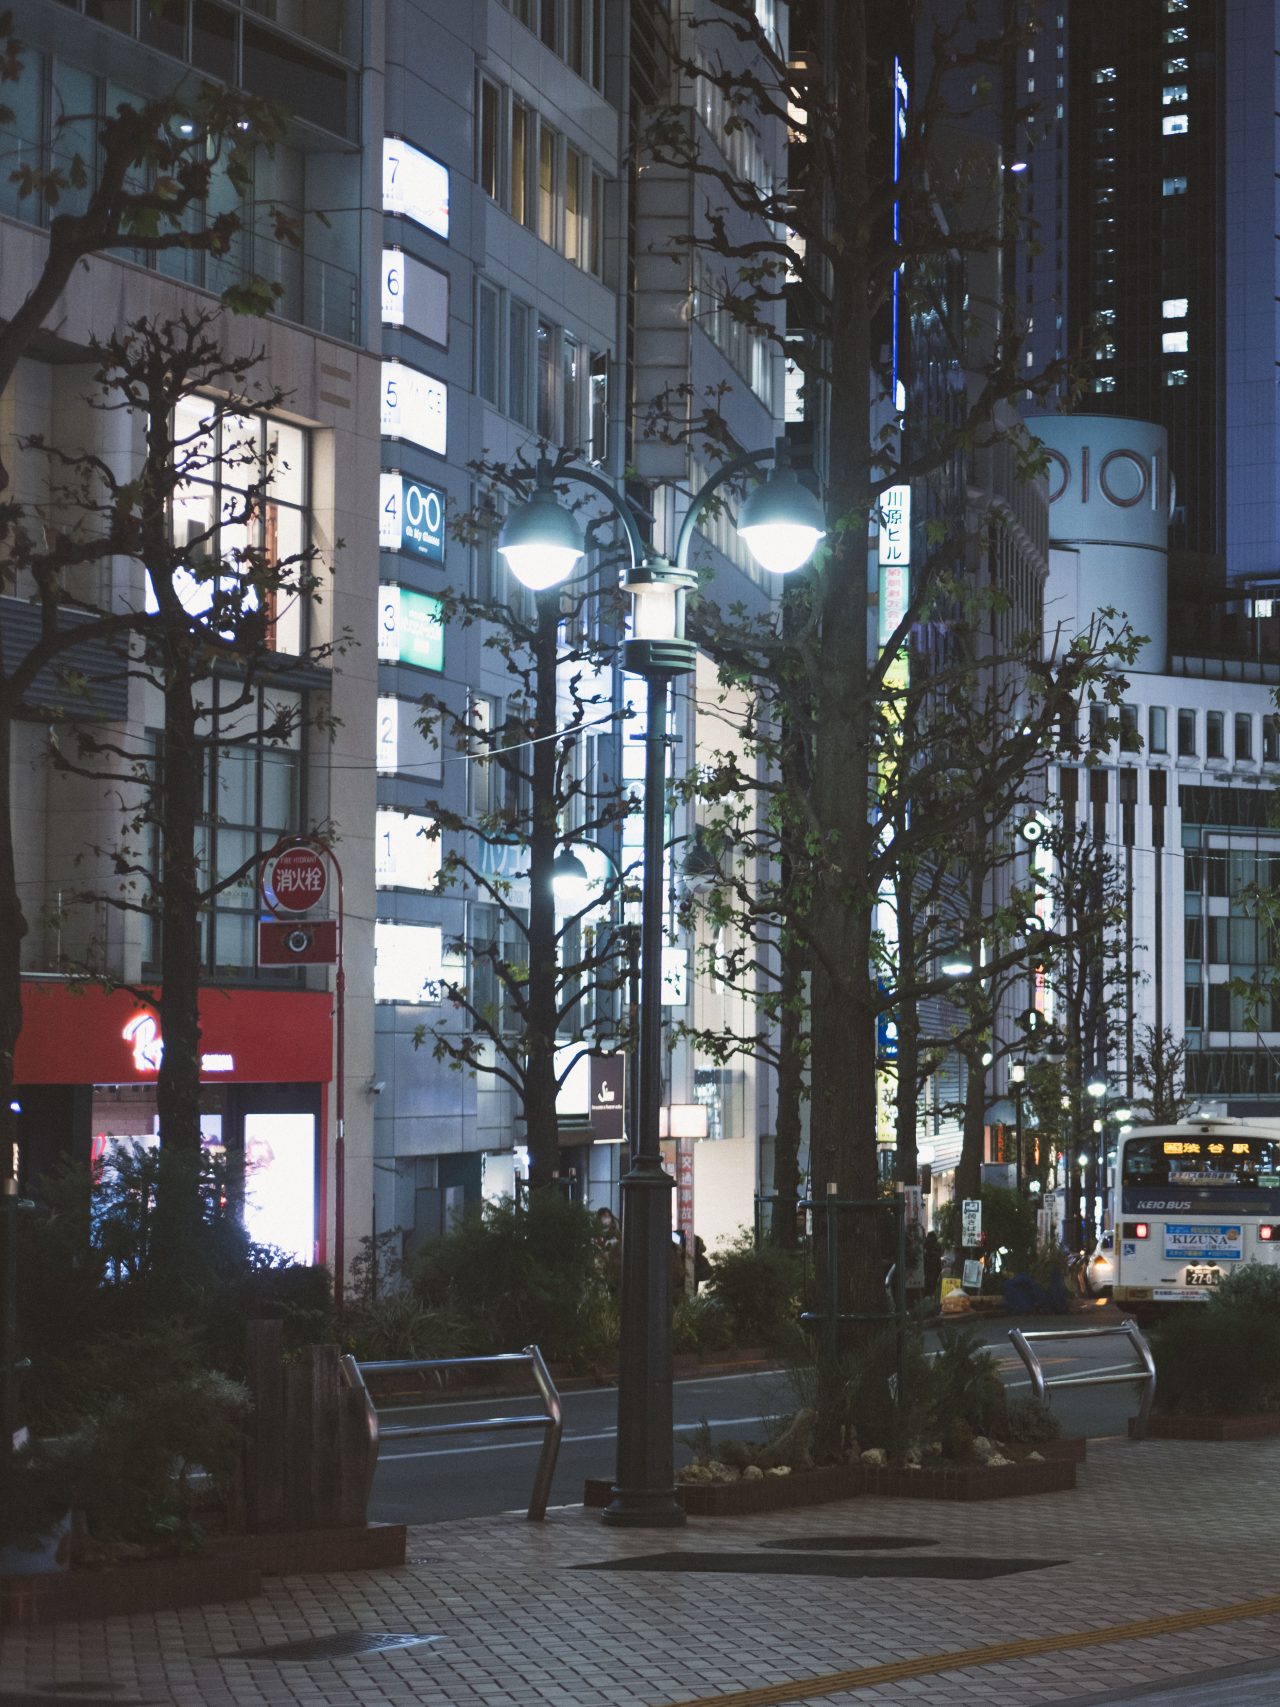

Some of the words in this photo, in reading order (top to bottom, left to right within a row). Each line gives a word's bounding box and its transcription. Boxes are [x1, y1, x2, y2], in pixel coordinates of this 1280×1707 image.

[388, 156, 400, 184] 7
[387, 268, 400, 296] 6
[386, 381, 398, 408] 5
[384, 493, 397, 520] 4
[383, 604, 395, 632] 3
[381, 716, 394, 744] 2
[383, 831, 391, 857] 1
[276, 867, 322, 893] 消火栓
[1137, 1200, 1166, 1209] KEIO
[1166, 1200, 1193, 1210] BUS
[1172, 1235, 1229, 1245] KIZUNA
